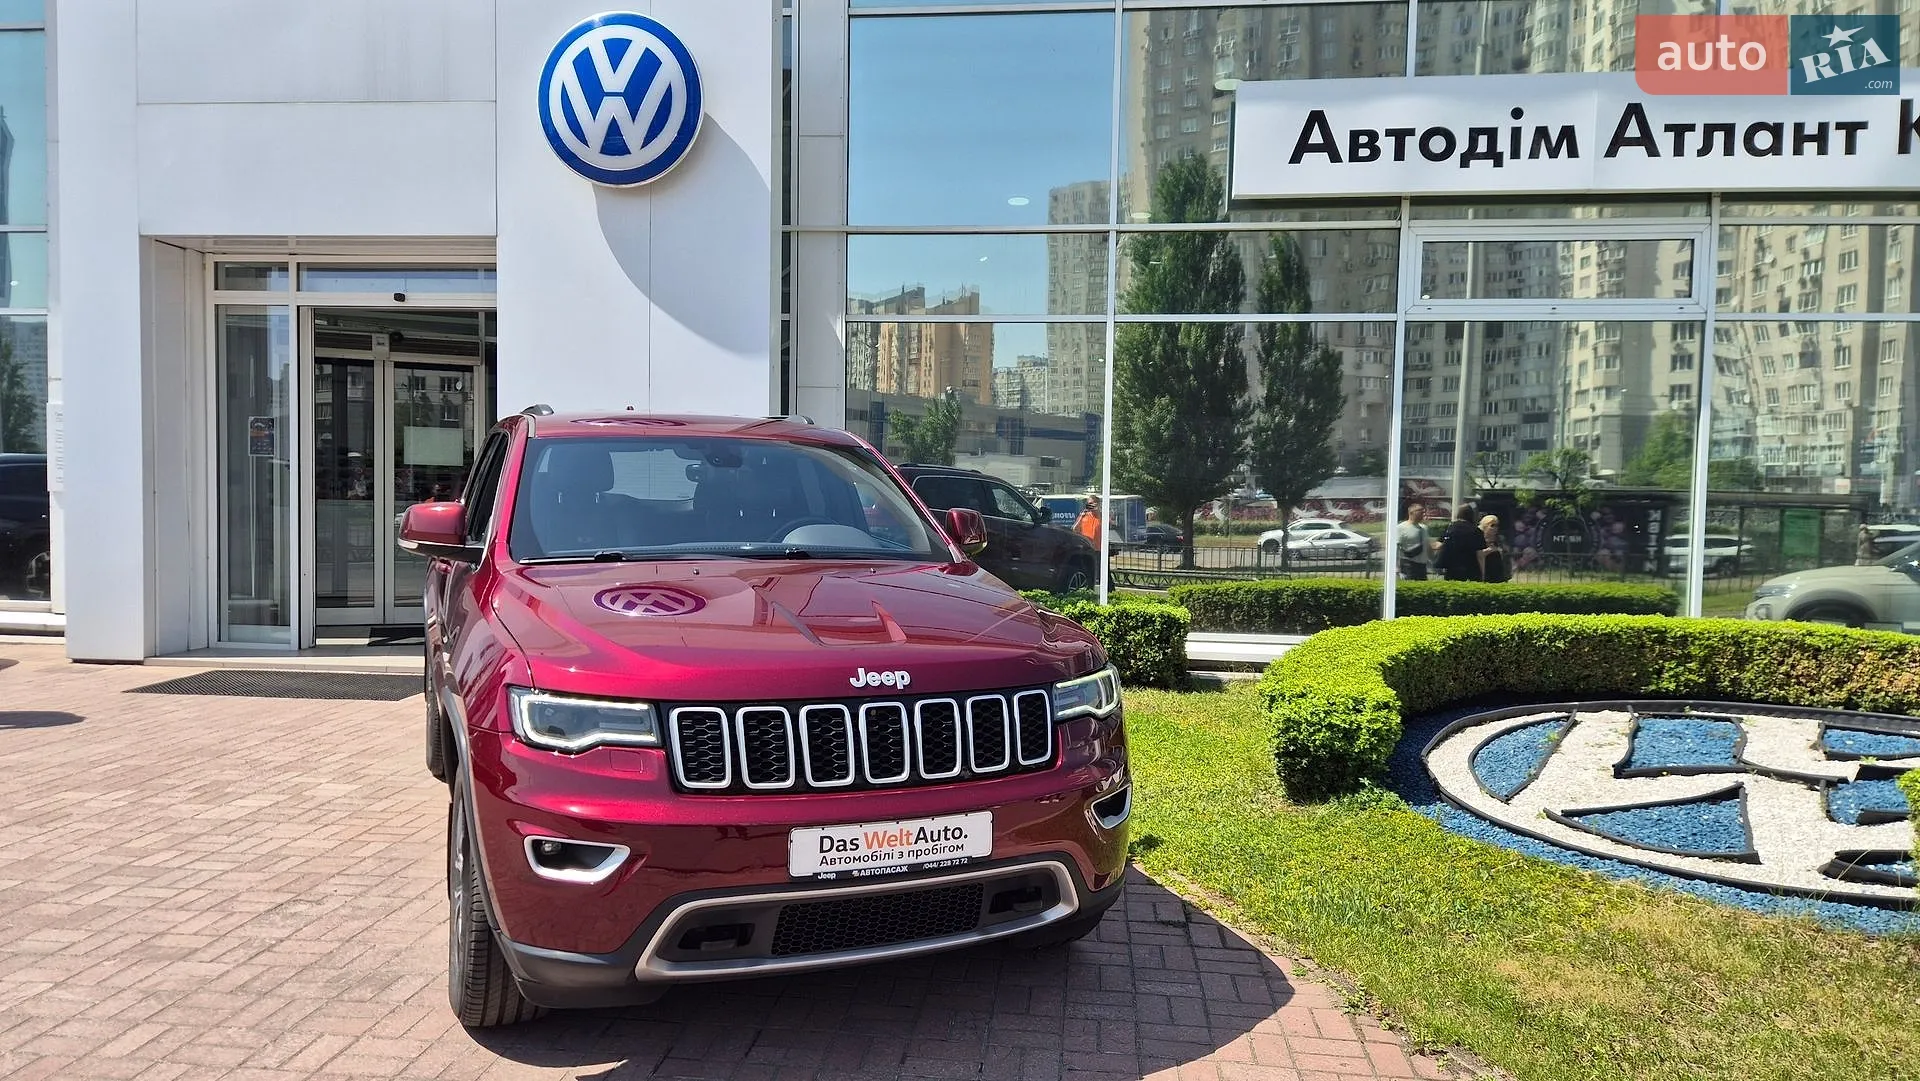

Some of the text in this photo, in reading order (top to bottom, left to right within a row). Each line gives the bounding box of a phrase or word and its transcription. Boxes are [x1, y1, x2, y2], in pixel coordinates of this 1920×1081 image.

[1288, 106, 1580, 169] Автодім
[1603, 102, 1869, 157] Атлант
[850, 667, 911, 690] Jeep
[819, 835, 860, 854] Das
[819, 843, 964, 867] Автомобілі з пробігом
[952, 858, 959, 866] 72
[960, 857, 968, 865] 72
[817, 872, 837, 880] Jeep
[860, 865, 908, 877] АВТОПАСАЖ
